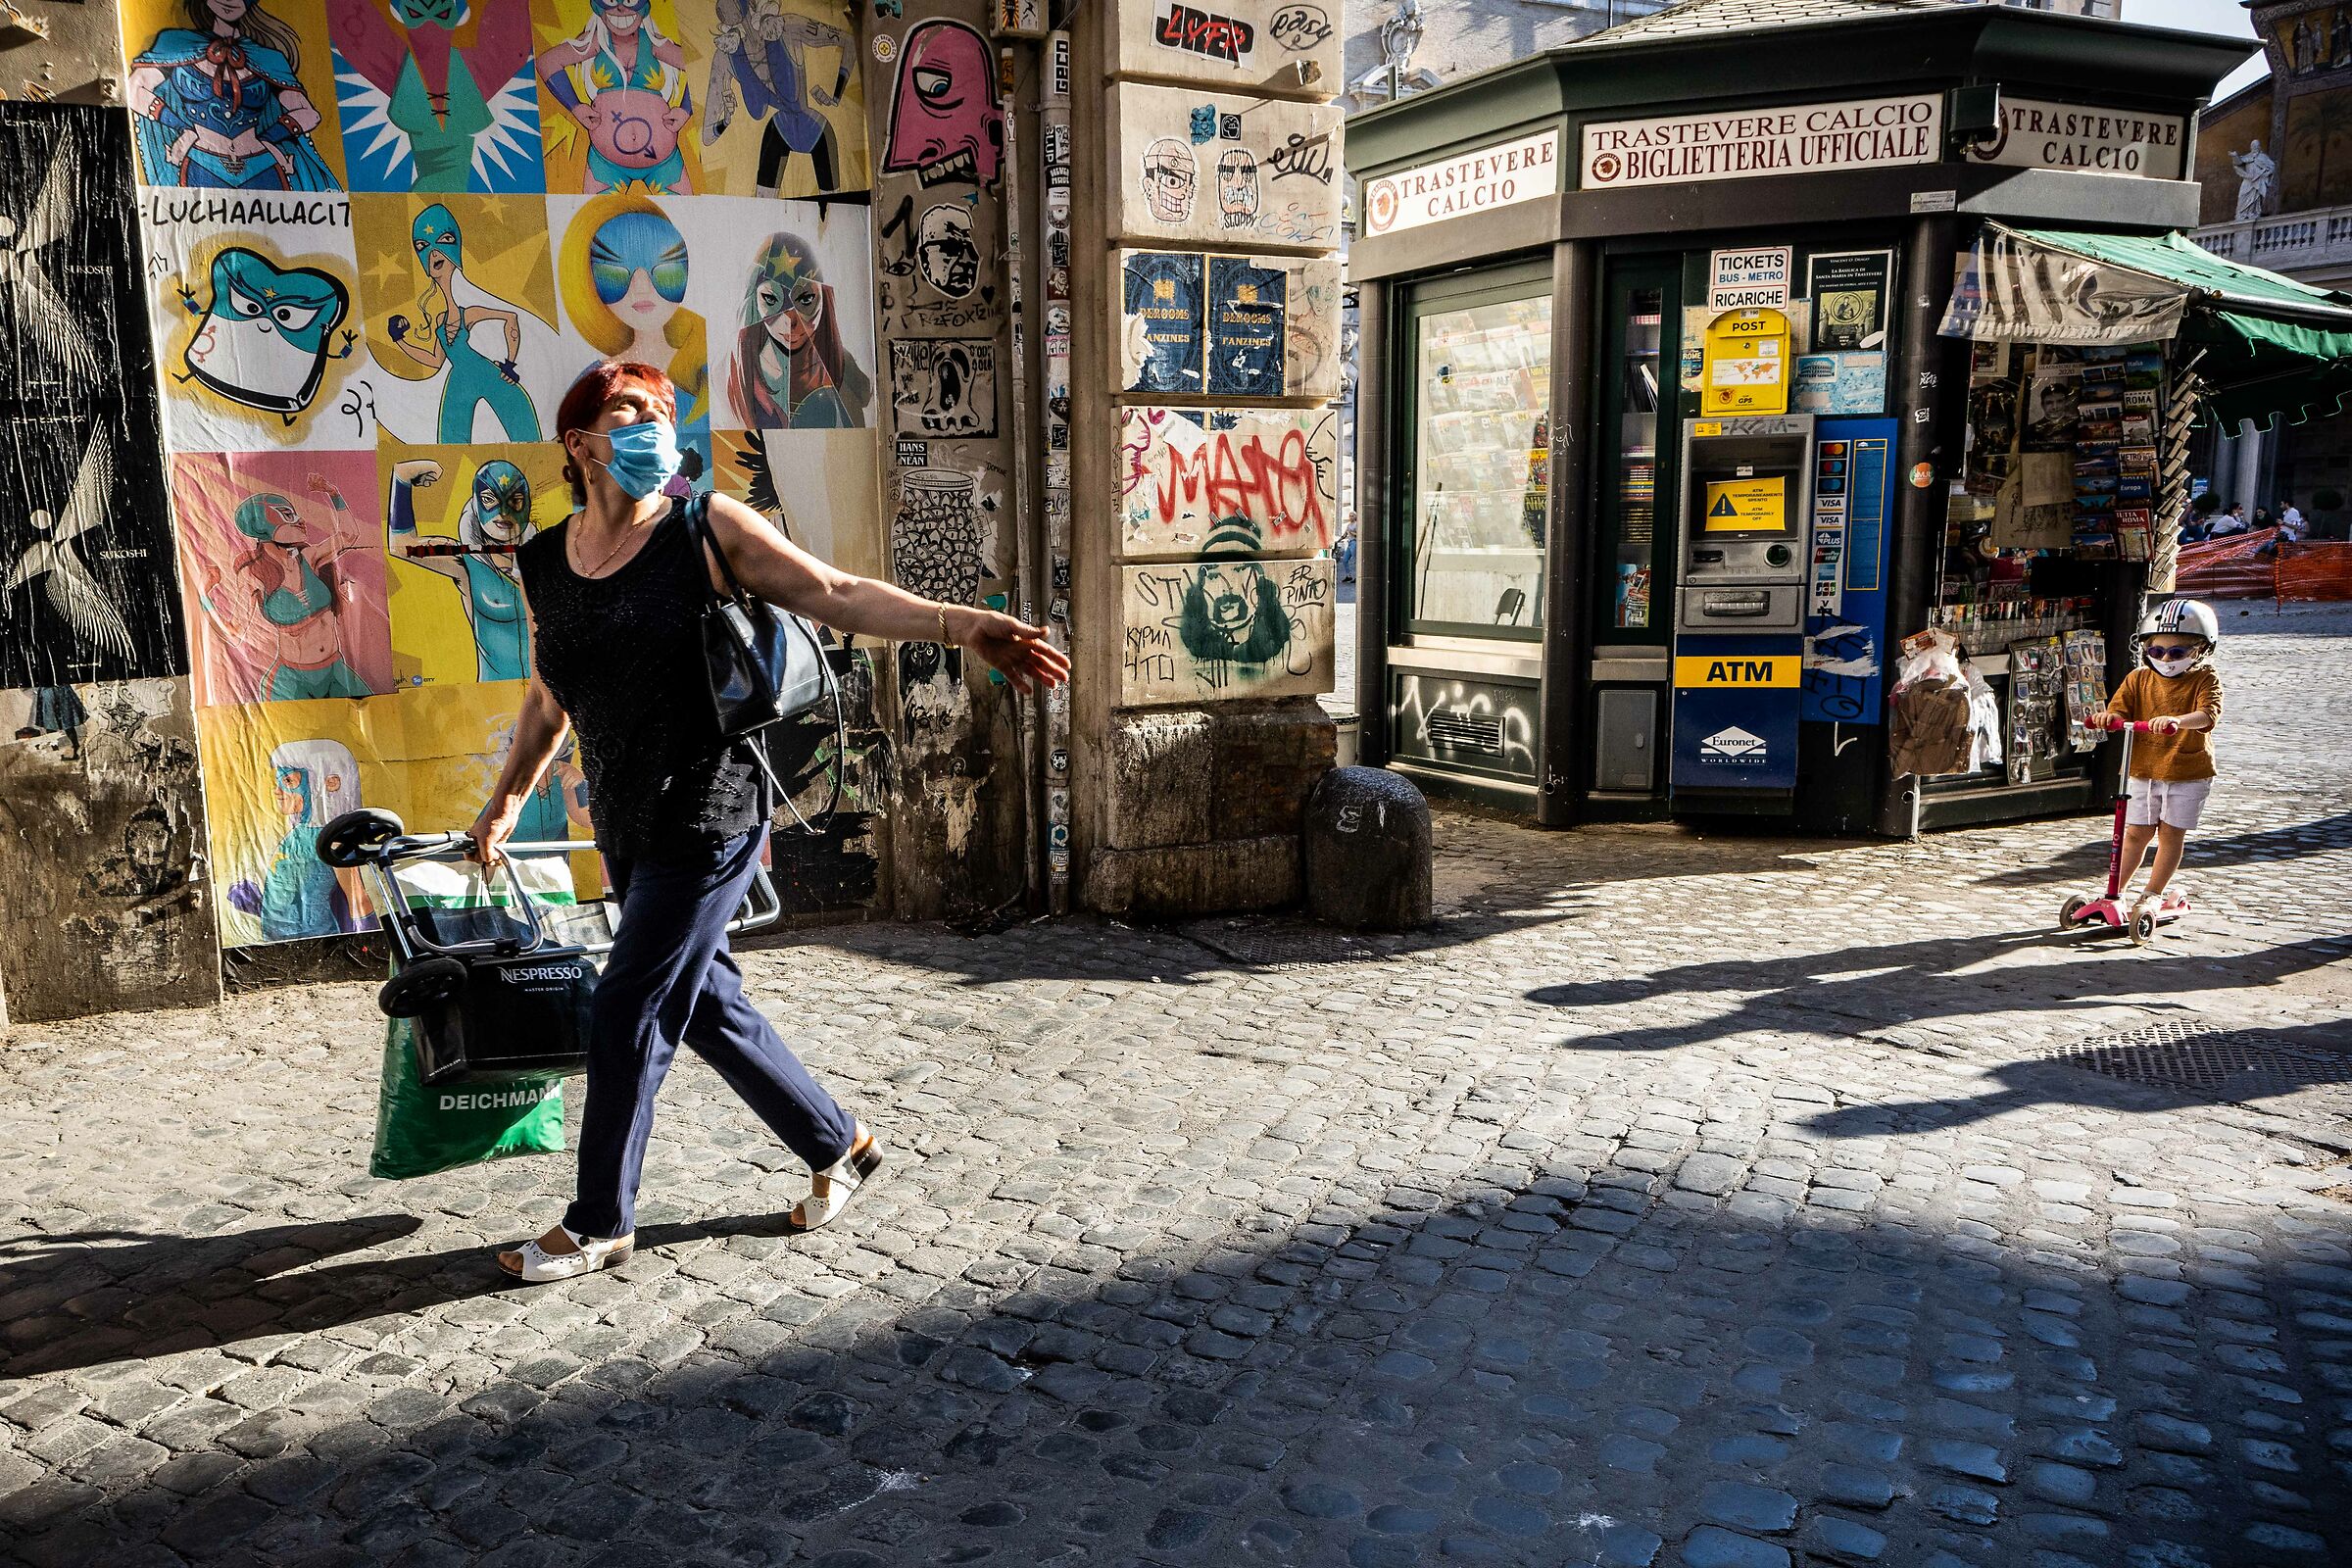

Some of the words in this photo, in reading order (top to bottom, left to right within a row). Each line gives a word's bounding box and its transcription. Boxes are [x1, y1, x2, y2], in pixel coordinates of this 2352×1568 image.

[1592, 115, 1796, 150] TRASTEVERE
[1806, 102, 1933, 132] CALCIO
[2012, 108, 2178, 145] TRASTEVERE
[1626, 137, 1791, 179] BIGLIETTERIA
[1800, 125, 1930, 166] UFFICIALE
[2042, 141, 2139, 172] CALCIO
[1400, 141, 1553, 199] TRASTEVERE
[1427, 179, 1515, 218] CALCIO
[1719, 254, 1785, 270] TICKETS
[1719, 273, 1740, 283] BUS
[1748, 271, 1784, 281] METRO
[1715, 291, 1783, 307] RICARICHE
[1732, 321, 1766, 331] POST
[1146, 333, 1190, 343] ANZINES
[900, 443, 924, 452] HANS
[100, 549, 147, 559] SUKOSHI
[1706, 662, 1773, 681] ATM
[1712, 736, 1757, 748] Euronet
[496, 966, 583, 984] NESPRESSO
